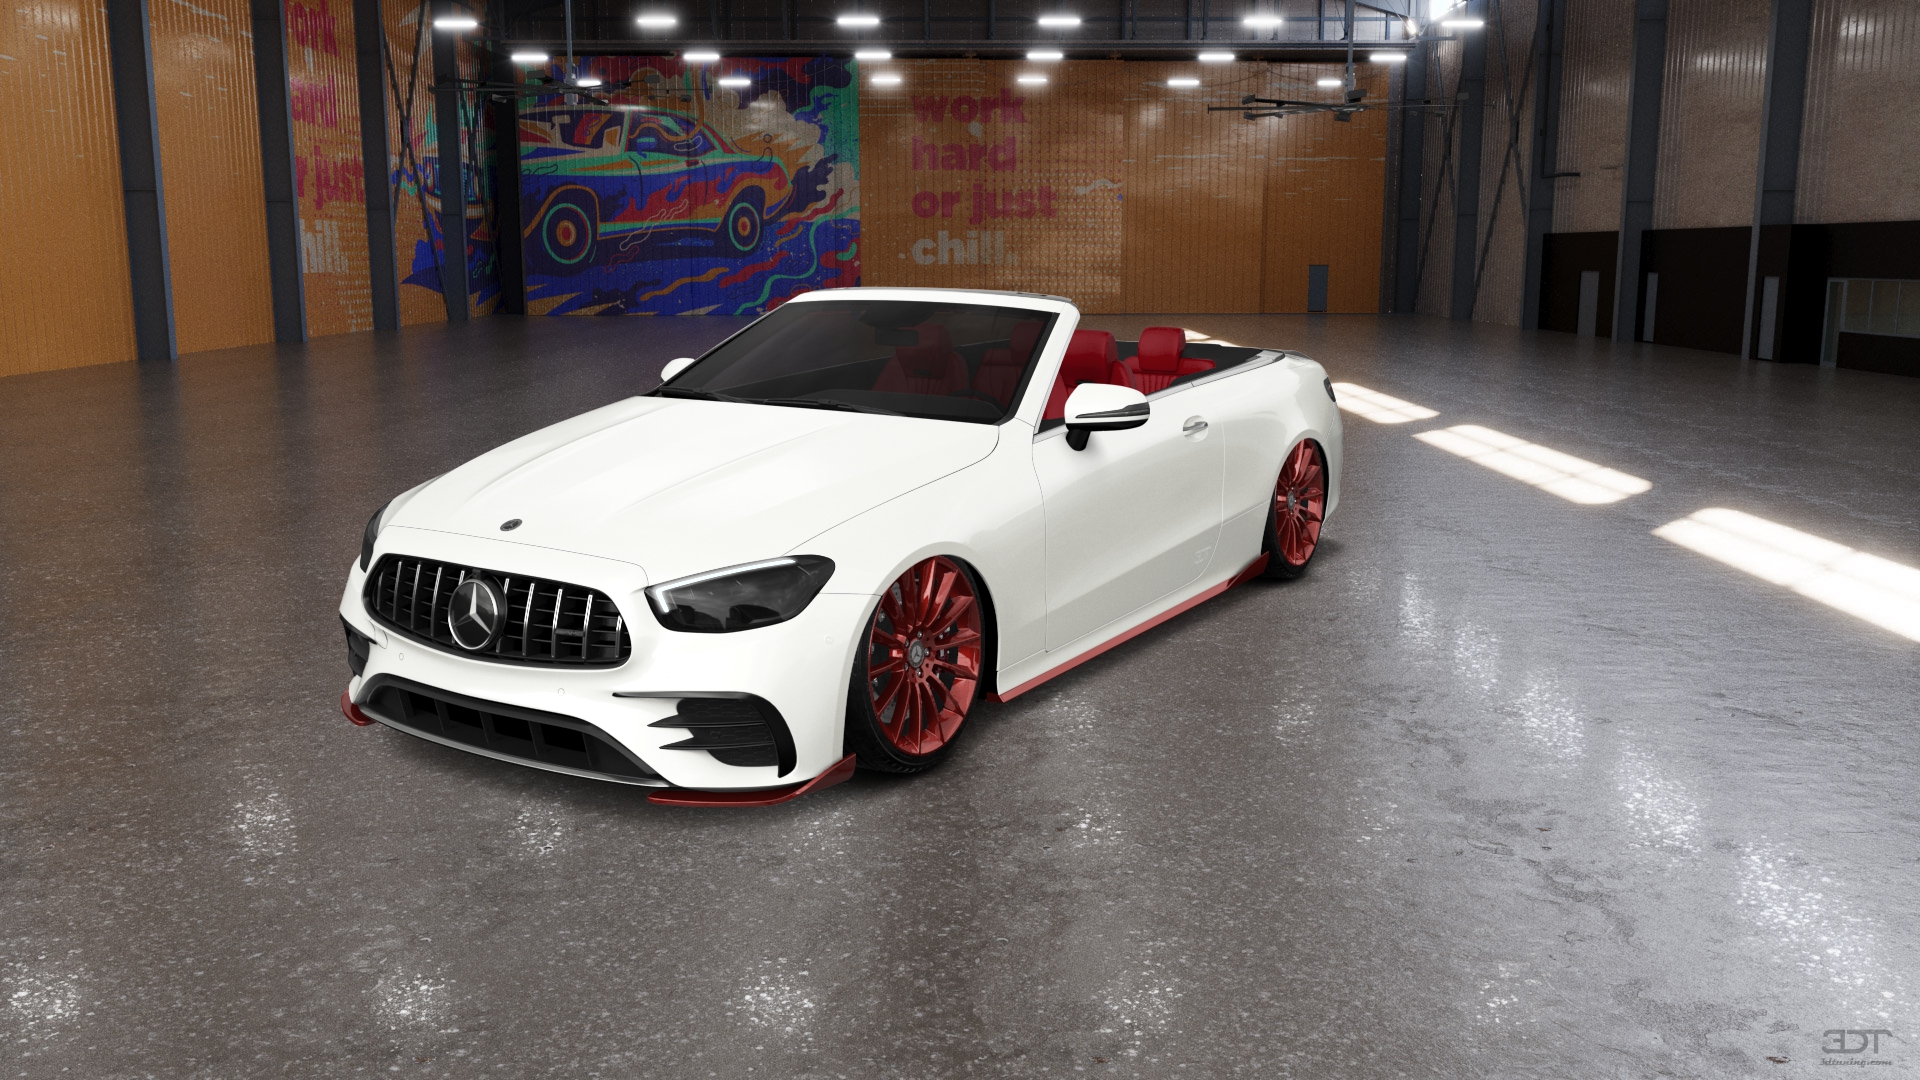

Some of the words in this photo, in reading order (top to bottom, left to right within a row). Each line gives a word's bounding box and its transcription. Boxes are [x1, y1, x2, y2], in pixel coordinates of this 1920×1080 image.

[284, 0, 338, 57] ork
[290, 75, 337, 128] ard
[911, 88, 1027, 123] work
[313, 145, 366, 210] just
[911, 136, 1017, 170] hard
[911, 191, 960, 218] or
[970, 183, 1059, 225] just
[299, 219, 348, 274] hill.
